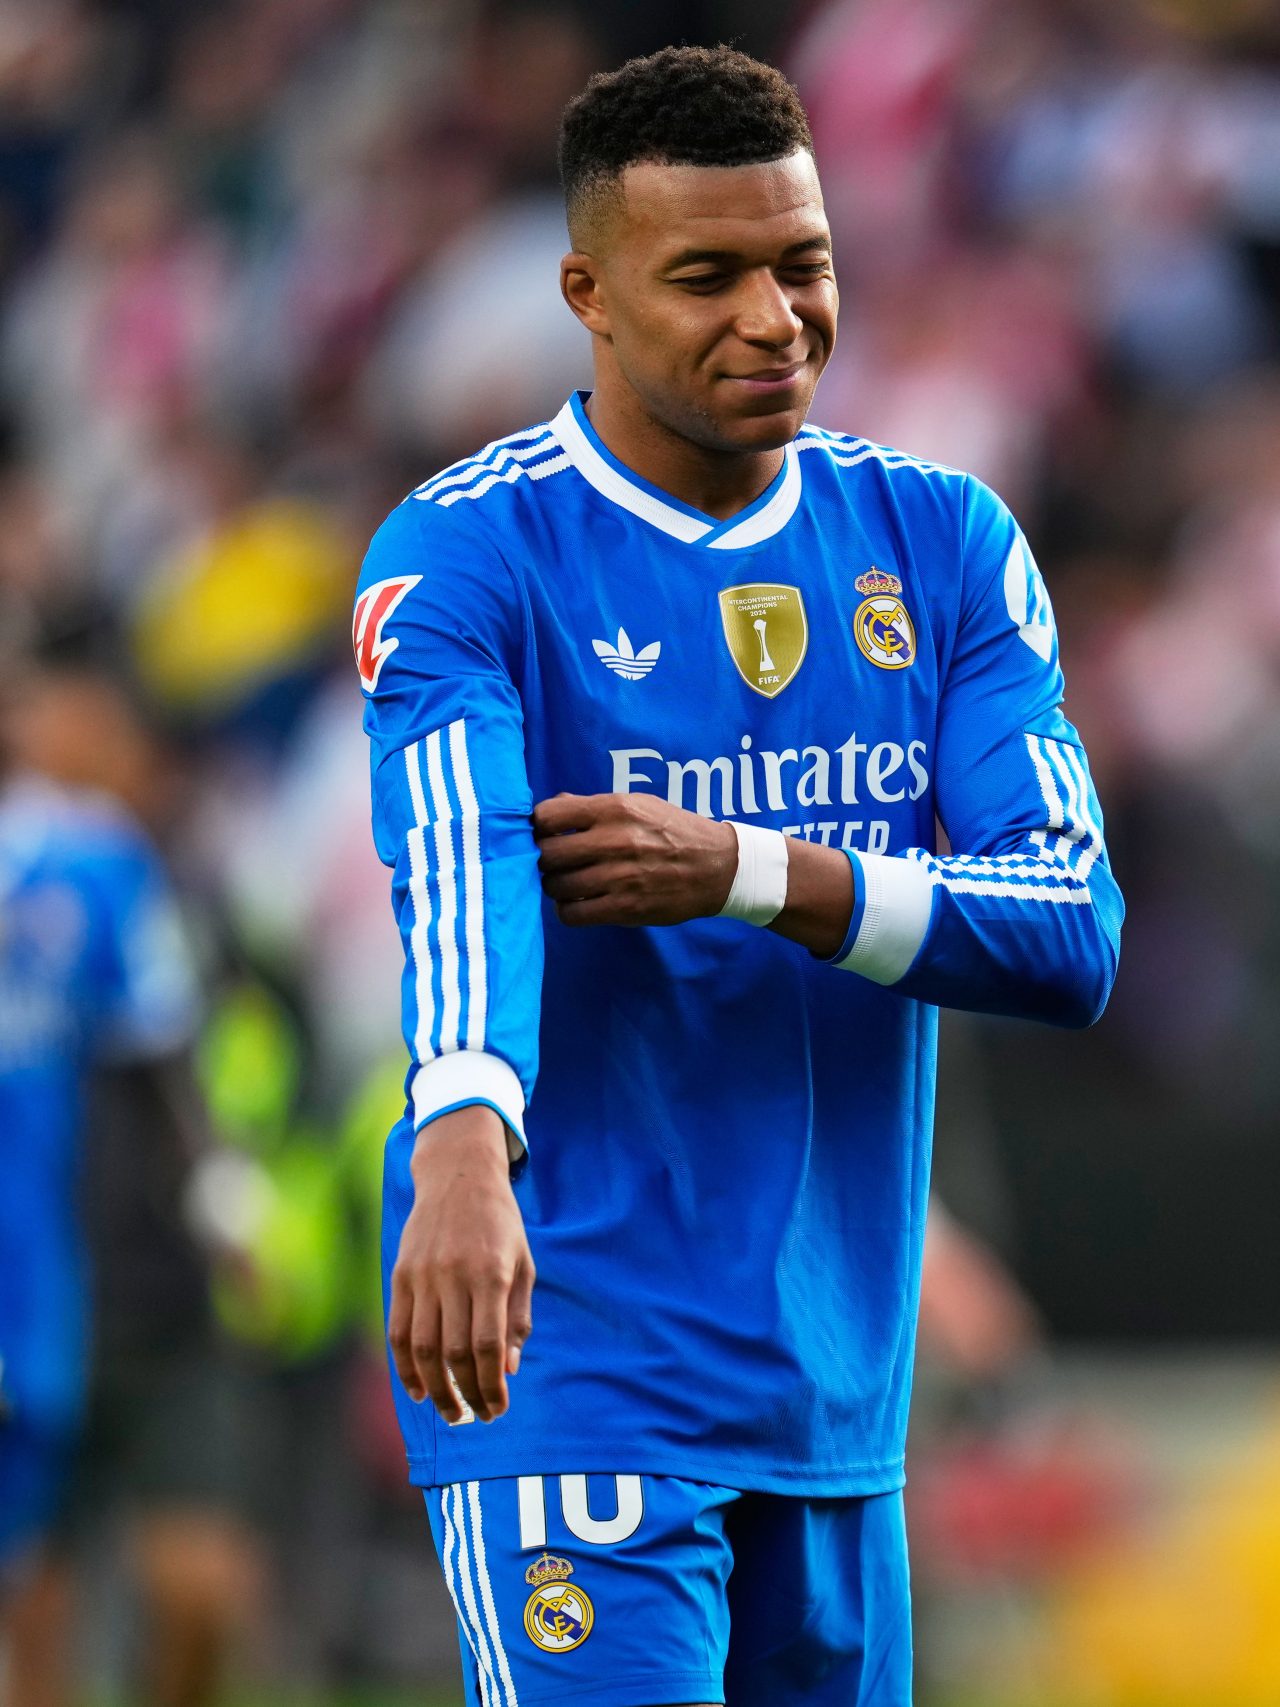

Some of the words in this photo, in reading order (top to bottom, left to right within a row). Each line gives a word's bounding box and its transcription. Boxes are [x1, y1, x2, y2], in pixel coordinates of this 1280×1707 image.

[737, 602, 778, 612] CHAMPIONS
[750, 609, 767, 617] 2024
[758, 675, 780, 686] FIFA
[608, 731, 929, 818] Emirates
